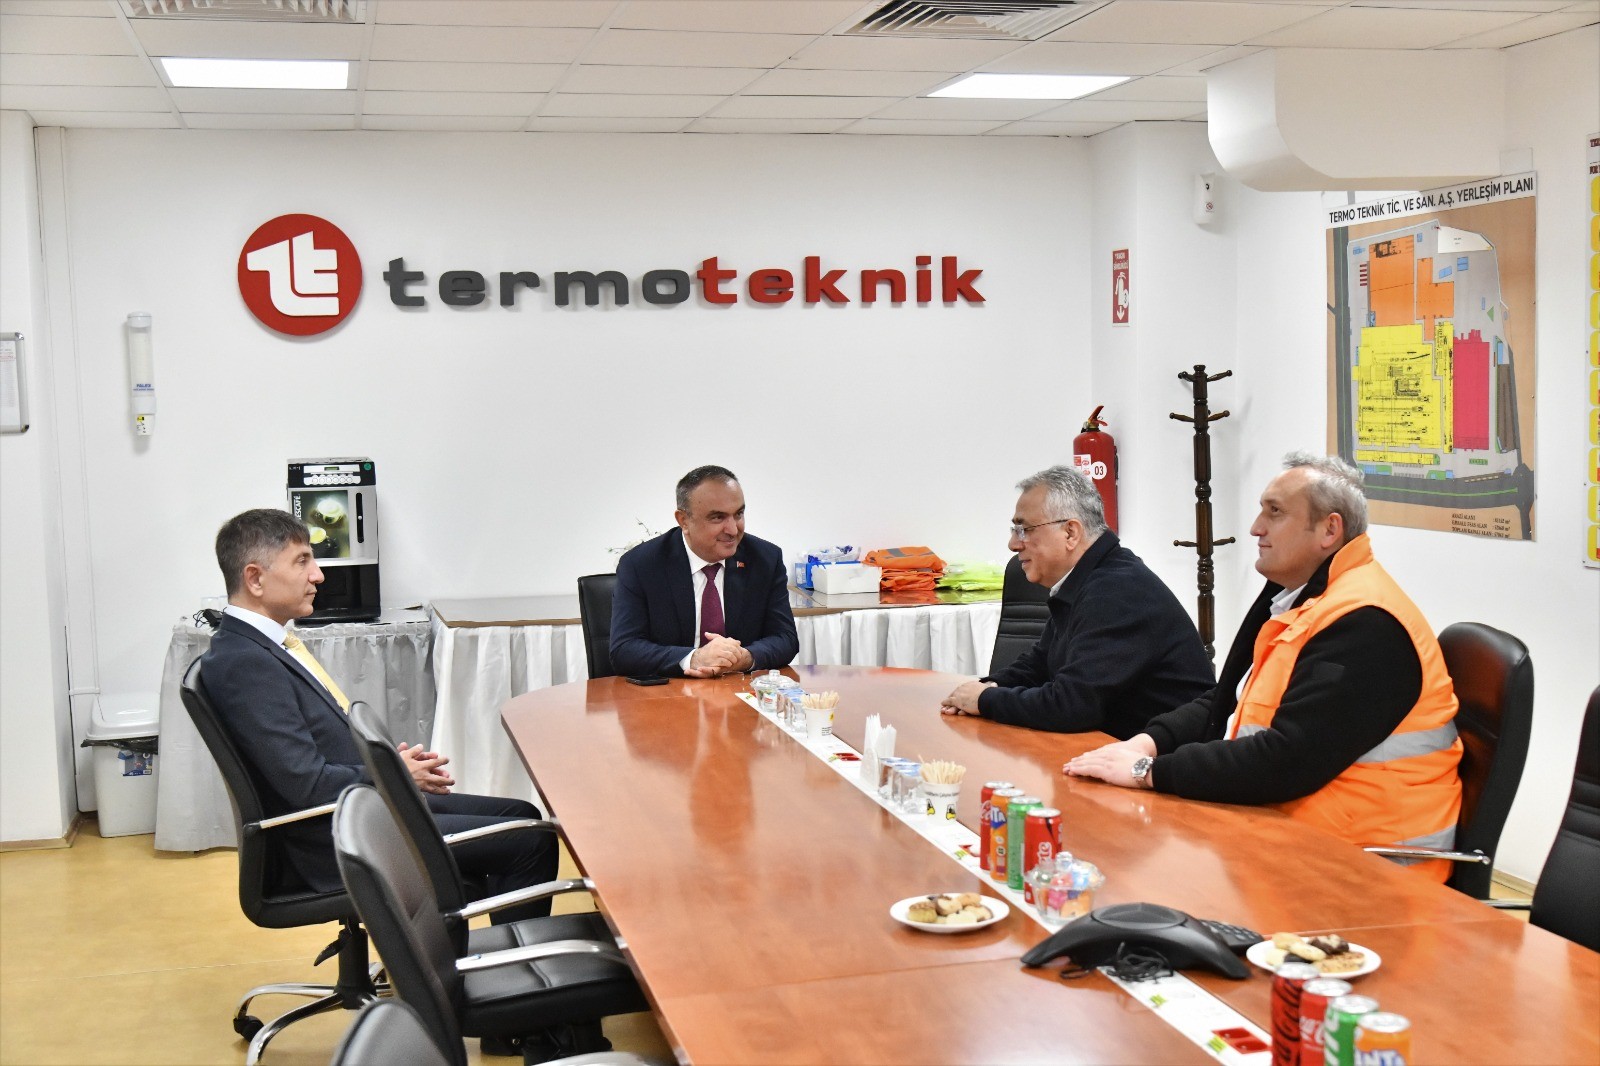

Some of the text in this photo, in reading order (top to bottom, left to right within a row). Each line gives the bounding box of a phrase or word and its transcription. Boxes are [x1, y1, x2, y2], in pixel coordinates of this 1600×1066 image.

[1329, 177, 1534, 223] TERMO TEKNİK TİC. VE SAN. A.Ş. YERLEŞİM PLANI
[382, 255, 987, 307] termoteknik
[1095, 466, 1104, 476] 03
[293, 494, 302, 521] ESCAFÉ
